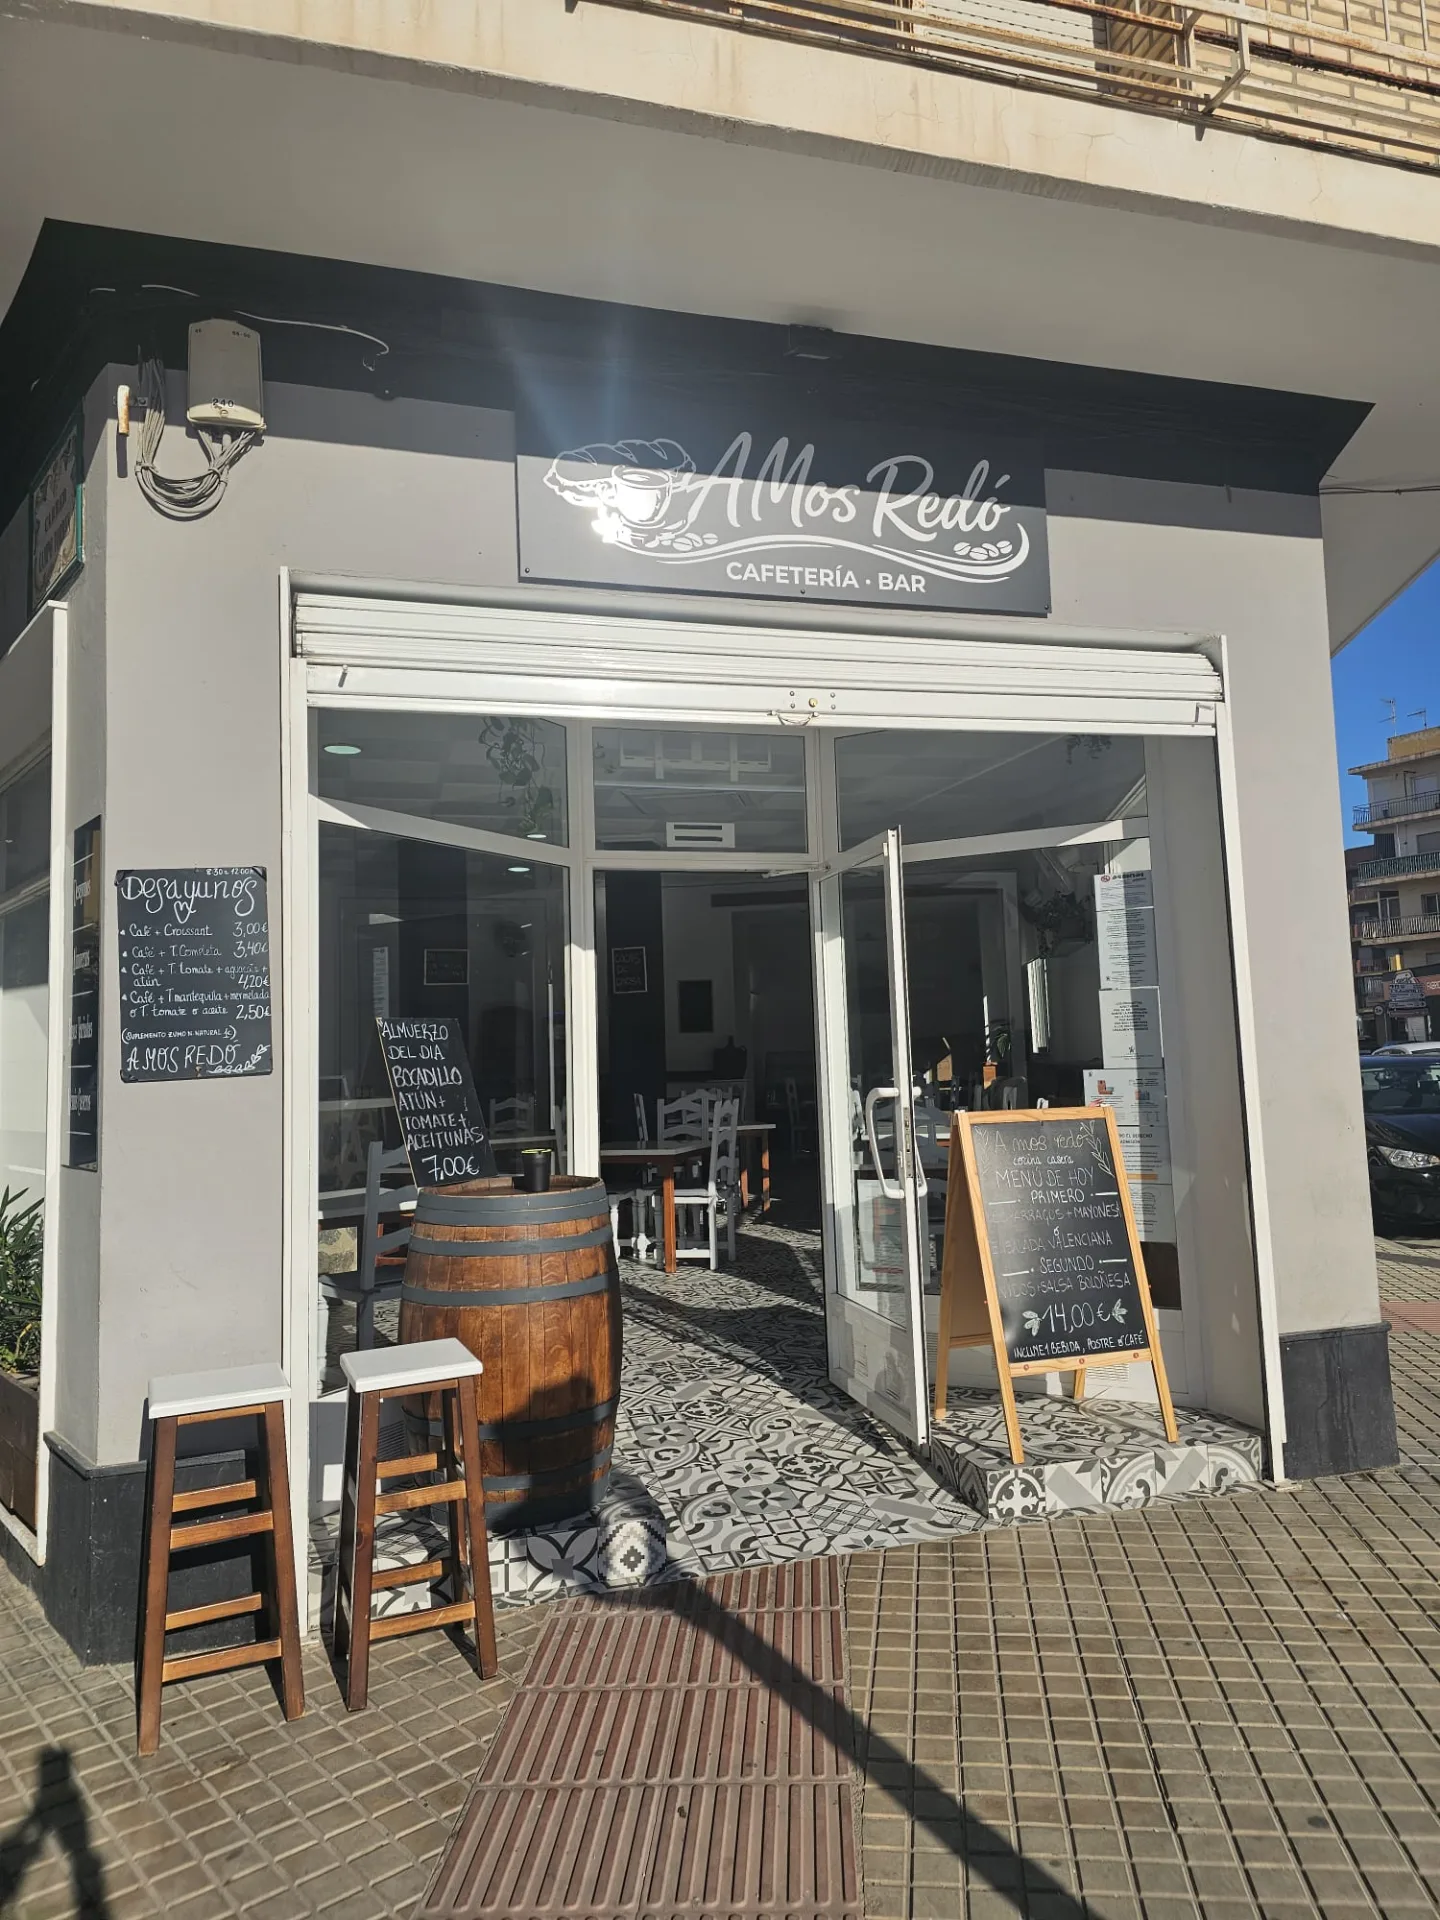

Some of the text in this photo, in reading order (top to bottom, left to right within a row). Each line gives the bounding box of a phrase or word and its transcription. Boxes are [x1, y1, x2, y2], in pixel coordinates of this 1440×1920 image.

[866, 454, 1011, 543] Redó
[726, 561, 927, 594] CAFETERÍA BAR
[121, 876, 257, 917] Desayunos
[129, 923, 151, 937] Café
[164, 923, 213, 937] Croissant
[232, 921, 268, 938] 3,00€
[131, 946, 155, 958] Café
[131, 963, 155, 976] Café
[133, 974, 270, 990] atún 4,20€
[129, 990, 155, 1004] Café
[151, 1003, 188, 1017] tomate
[202, 1006, 229, 1015] aceite
[235, 1004, 272, 1020] 2,50€
[382, 1023, 449, 1042] ALMUERZO
[388, 1046, 417, 1060] DEL
[391, 1065, 463, 1088] BOCADILLO
[406, 1126, 484, 1151] ACEITUNAS
[421, 1154, 480, 1182] 7,00€
[1046, 1154, 1074, 1165] casera
[995, 1165, 1095, 1189] MENÚ DE HOY
[1030, 1188, 1085, 1205] PRIMERO
[1048, 1230, 1113, 1250] VALENCIANA
[1040, 1255, 1095, 1274] SEGUNDO
[1077, 1270, 1131, 1291] BOLOÑESA
[1087, 1336, 1116, 1351] POSTRE
[1124, 1331, 1145, 1346] CAFÉ
